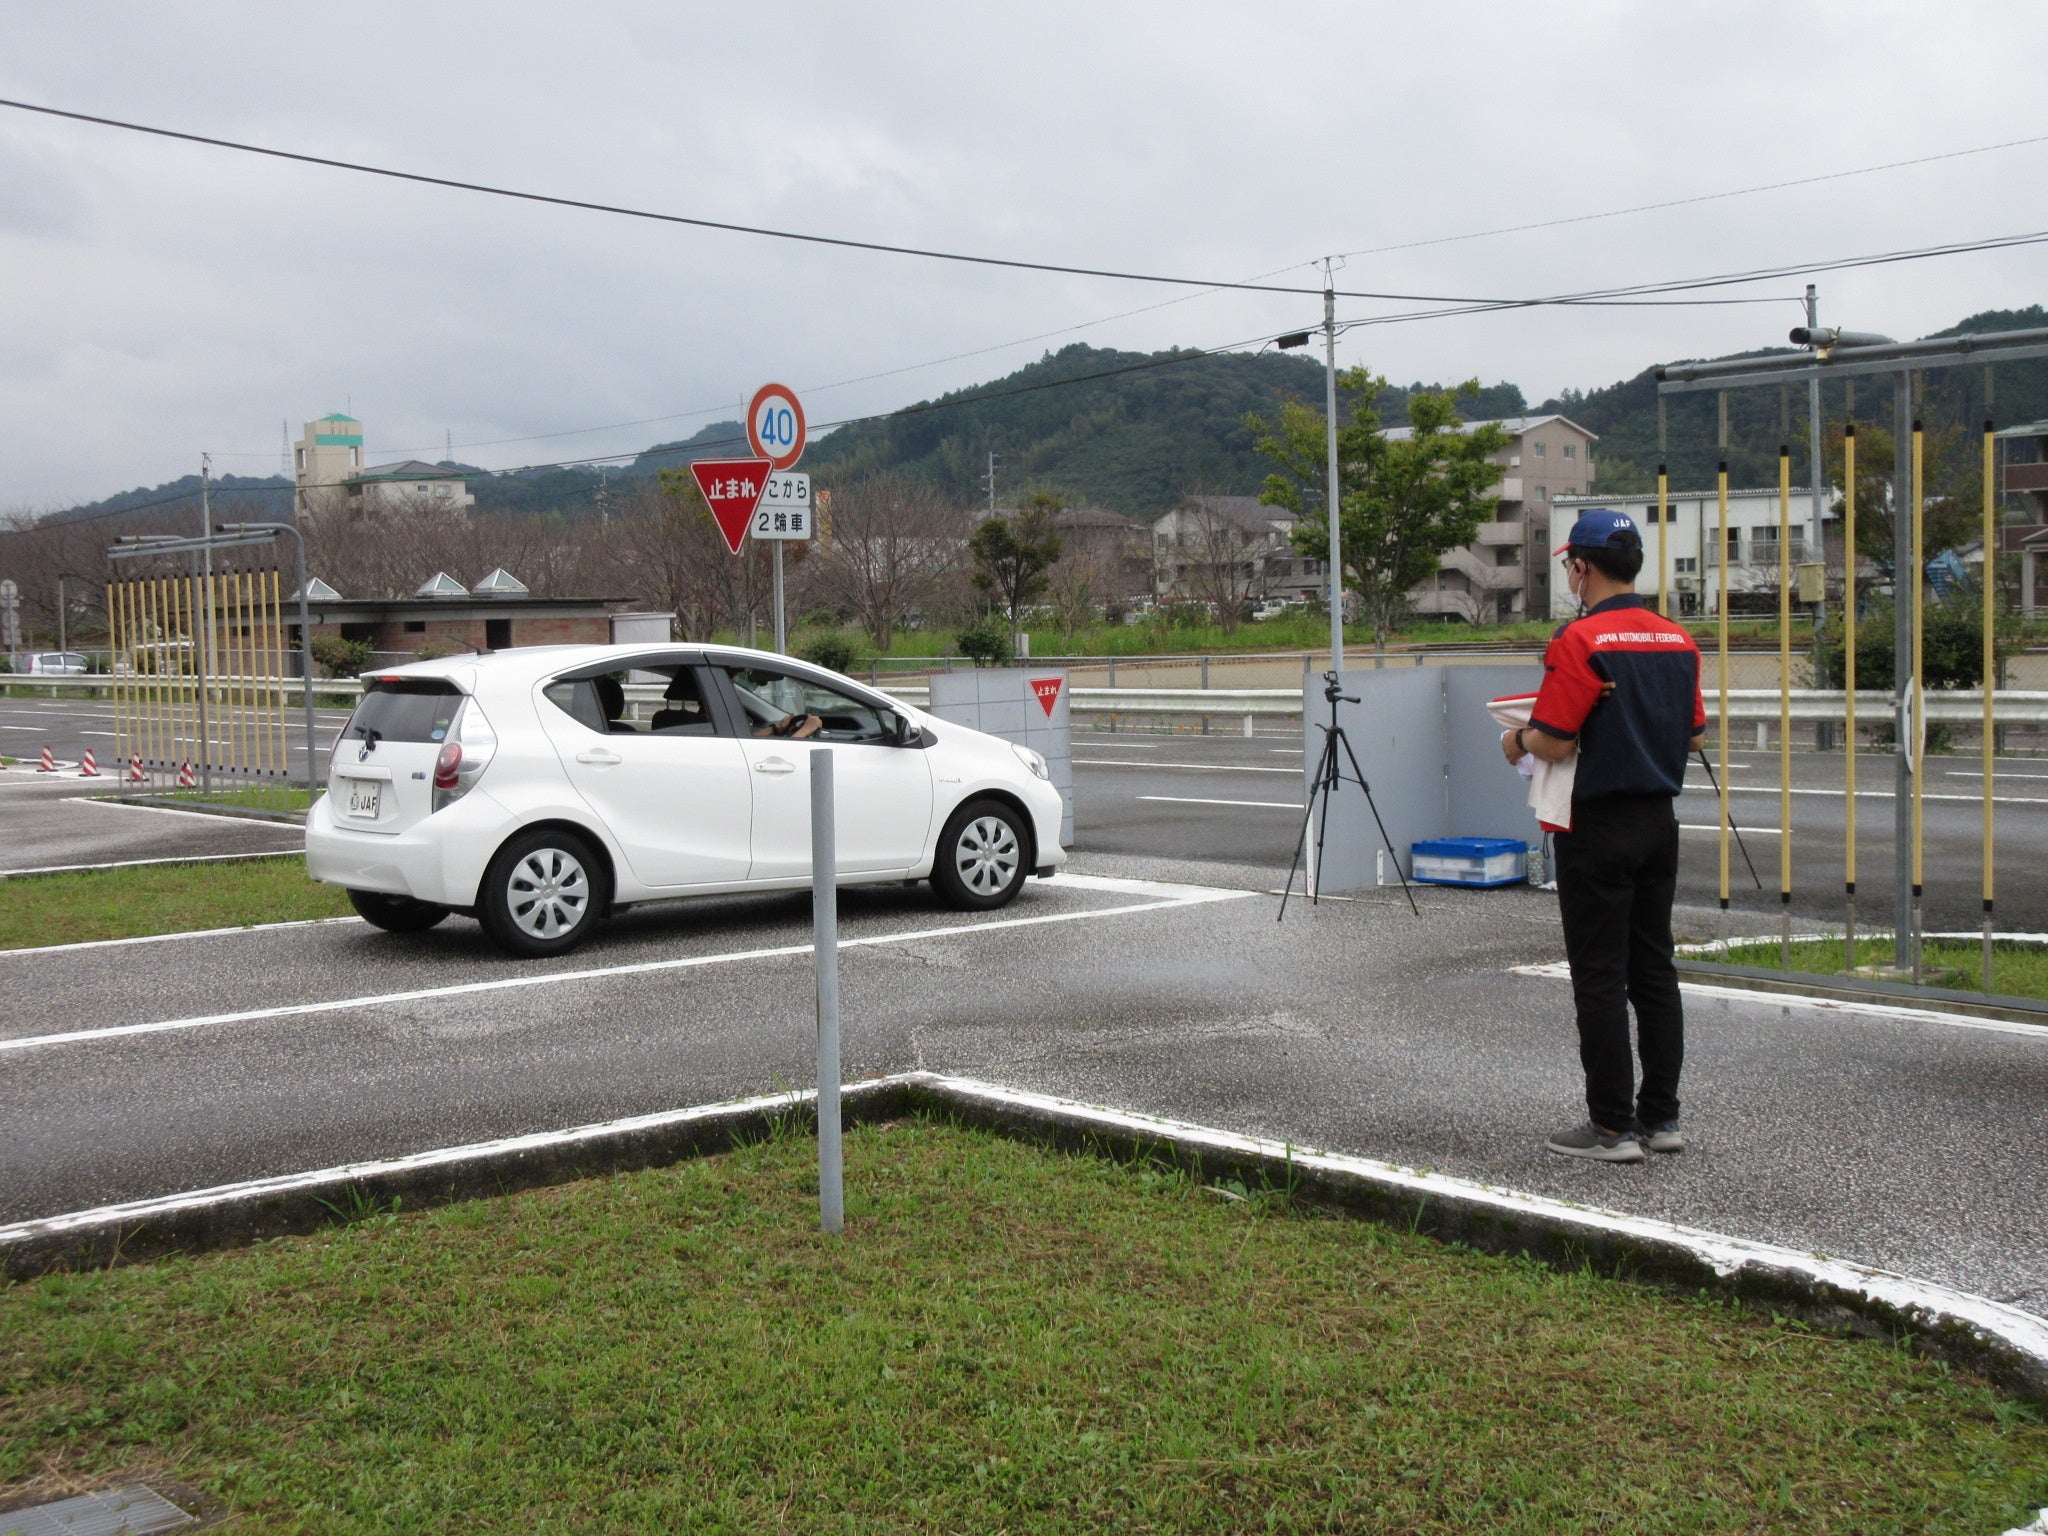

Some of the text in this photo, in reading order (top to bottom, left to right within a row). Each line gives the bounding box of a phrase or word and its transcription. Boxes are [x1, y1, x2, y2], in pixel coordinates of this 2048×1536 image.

[762, 408, 793, 446] 40
[709, 478, 757, 500] 止まれ
[758, 512, 803, 532] 2輪車
[1613, 519, 1631, 528] JAF
[1595, 633, 1618, 645] JAPAN
[1618, 632, 1655, 643] AUTOMOBILE
[1038, 685, 1057, 697] 止まれ
[361, 795, 377, 811] JAF
